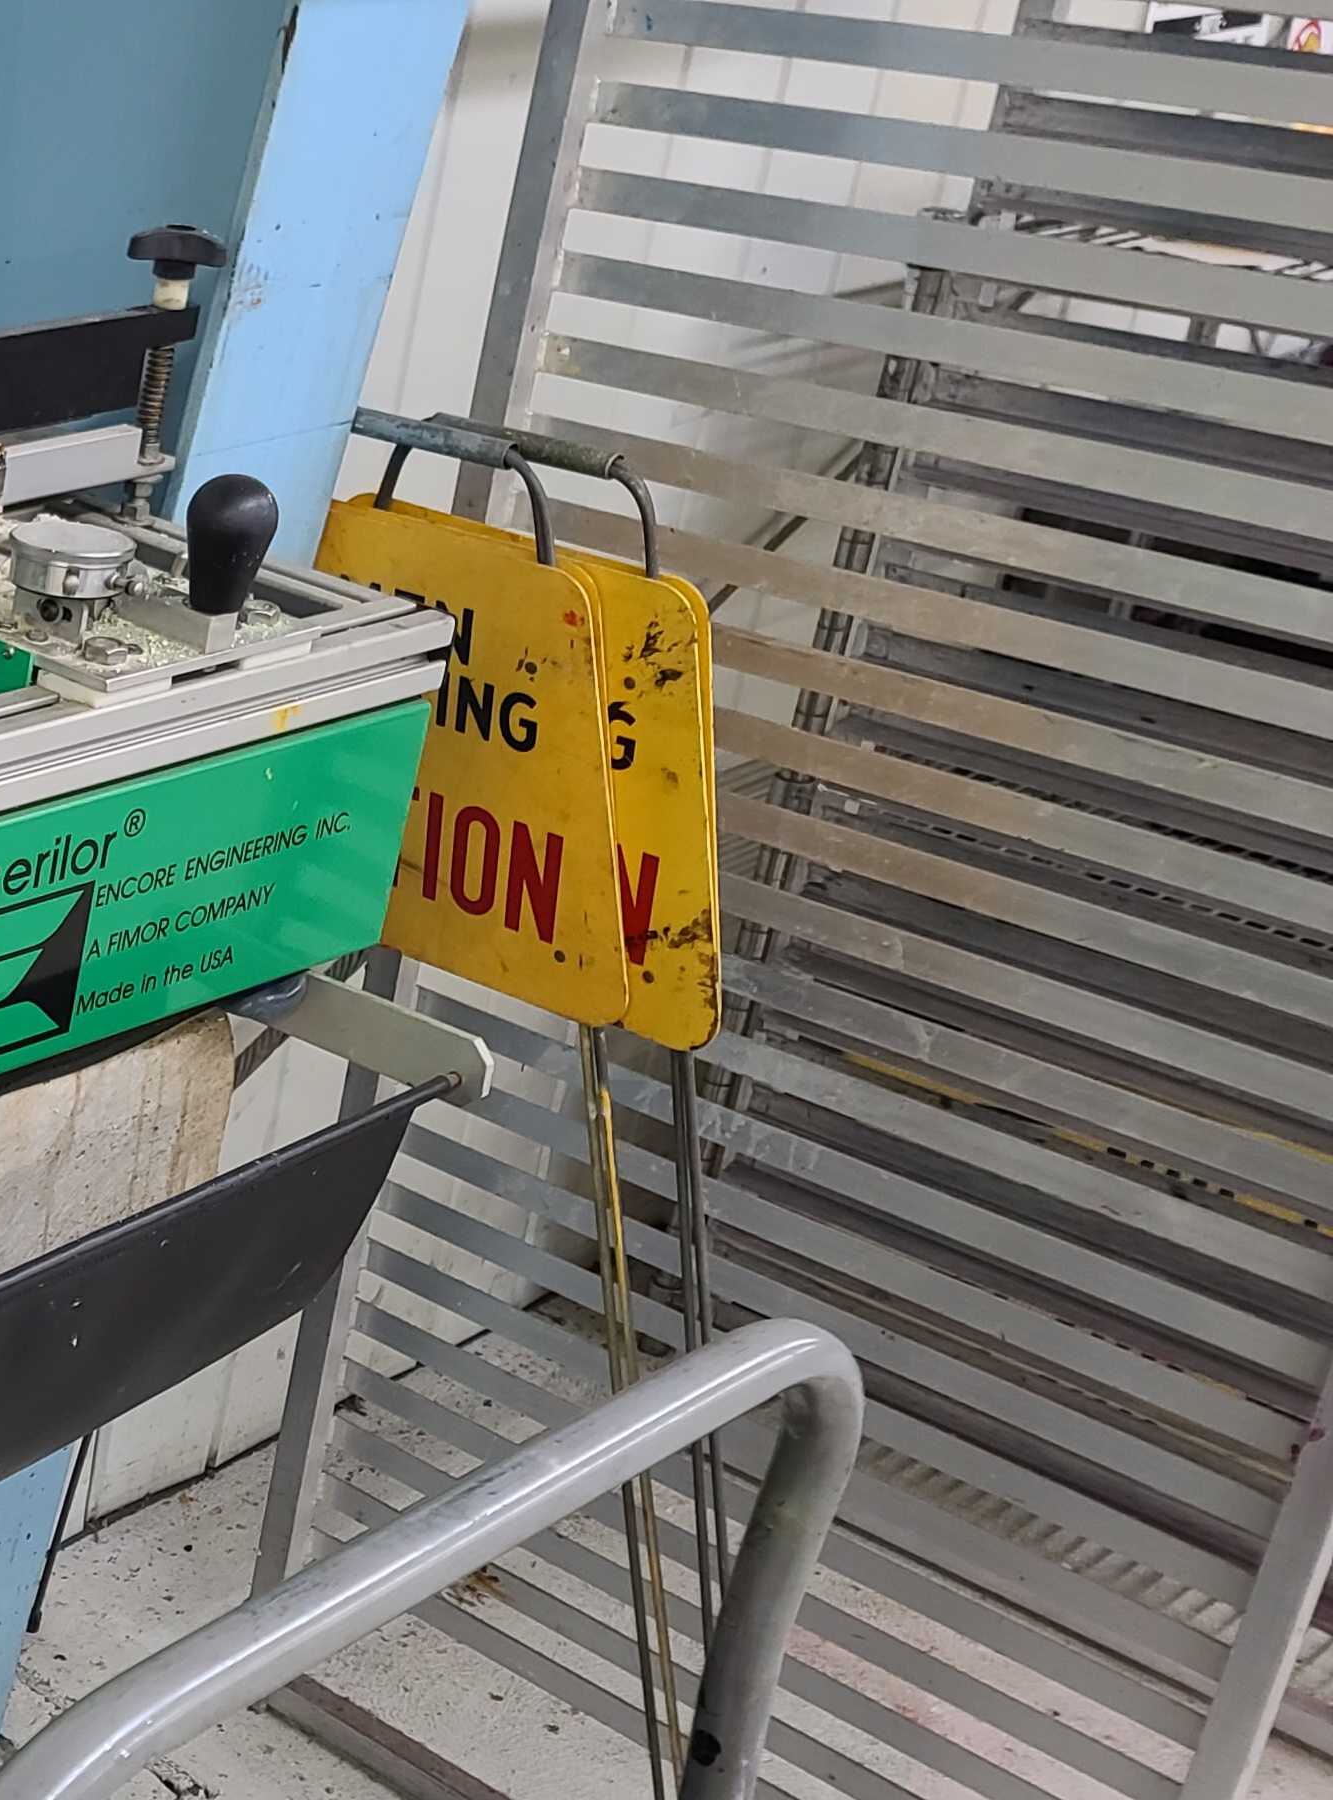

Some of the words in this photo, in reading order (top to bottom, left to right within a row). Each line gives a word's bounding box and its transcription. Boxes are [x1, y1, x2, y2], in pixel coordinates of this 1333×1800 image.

[95, 863, 177, 908] ENCORE
[184, 824, 308, 881] ENGINEERING
[315, 811, 351, 840] INC.
[85, 938, 101, 963] A
[106, 918, 169, 955] FIMOR
[175, 883, 276, 933] COMPANY
[76, 979, 133, 1016] Made
[141, 971, 157, 994] in
[163, 962, 194, 988] the
[200, 946, 233, 976] USA
